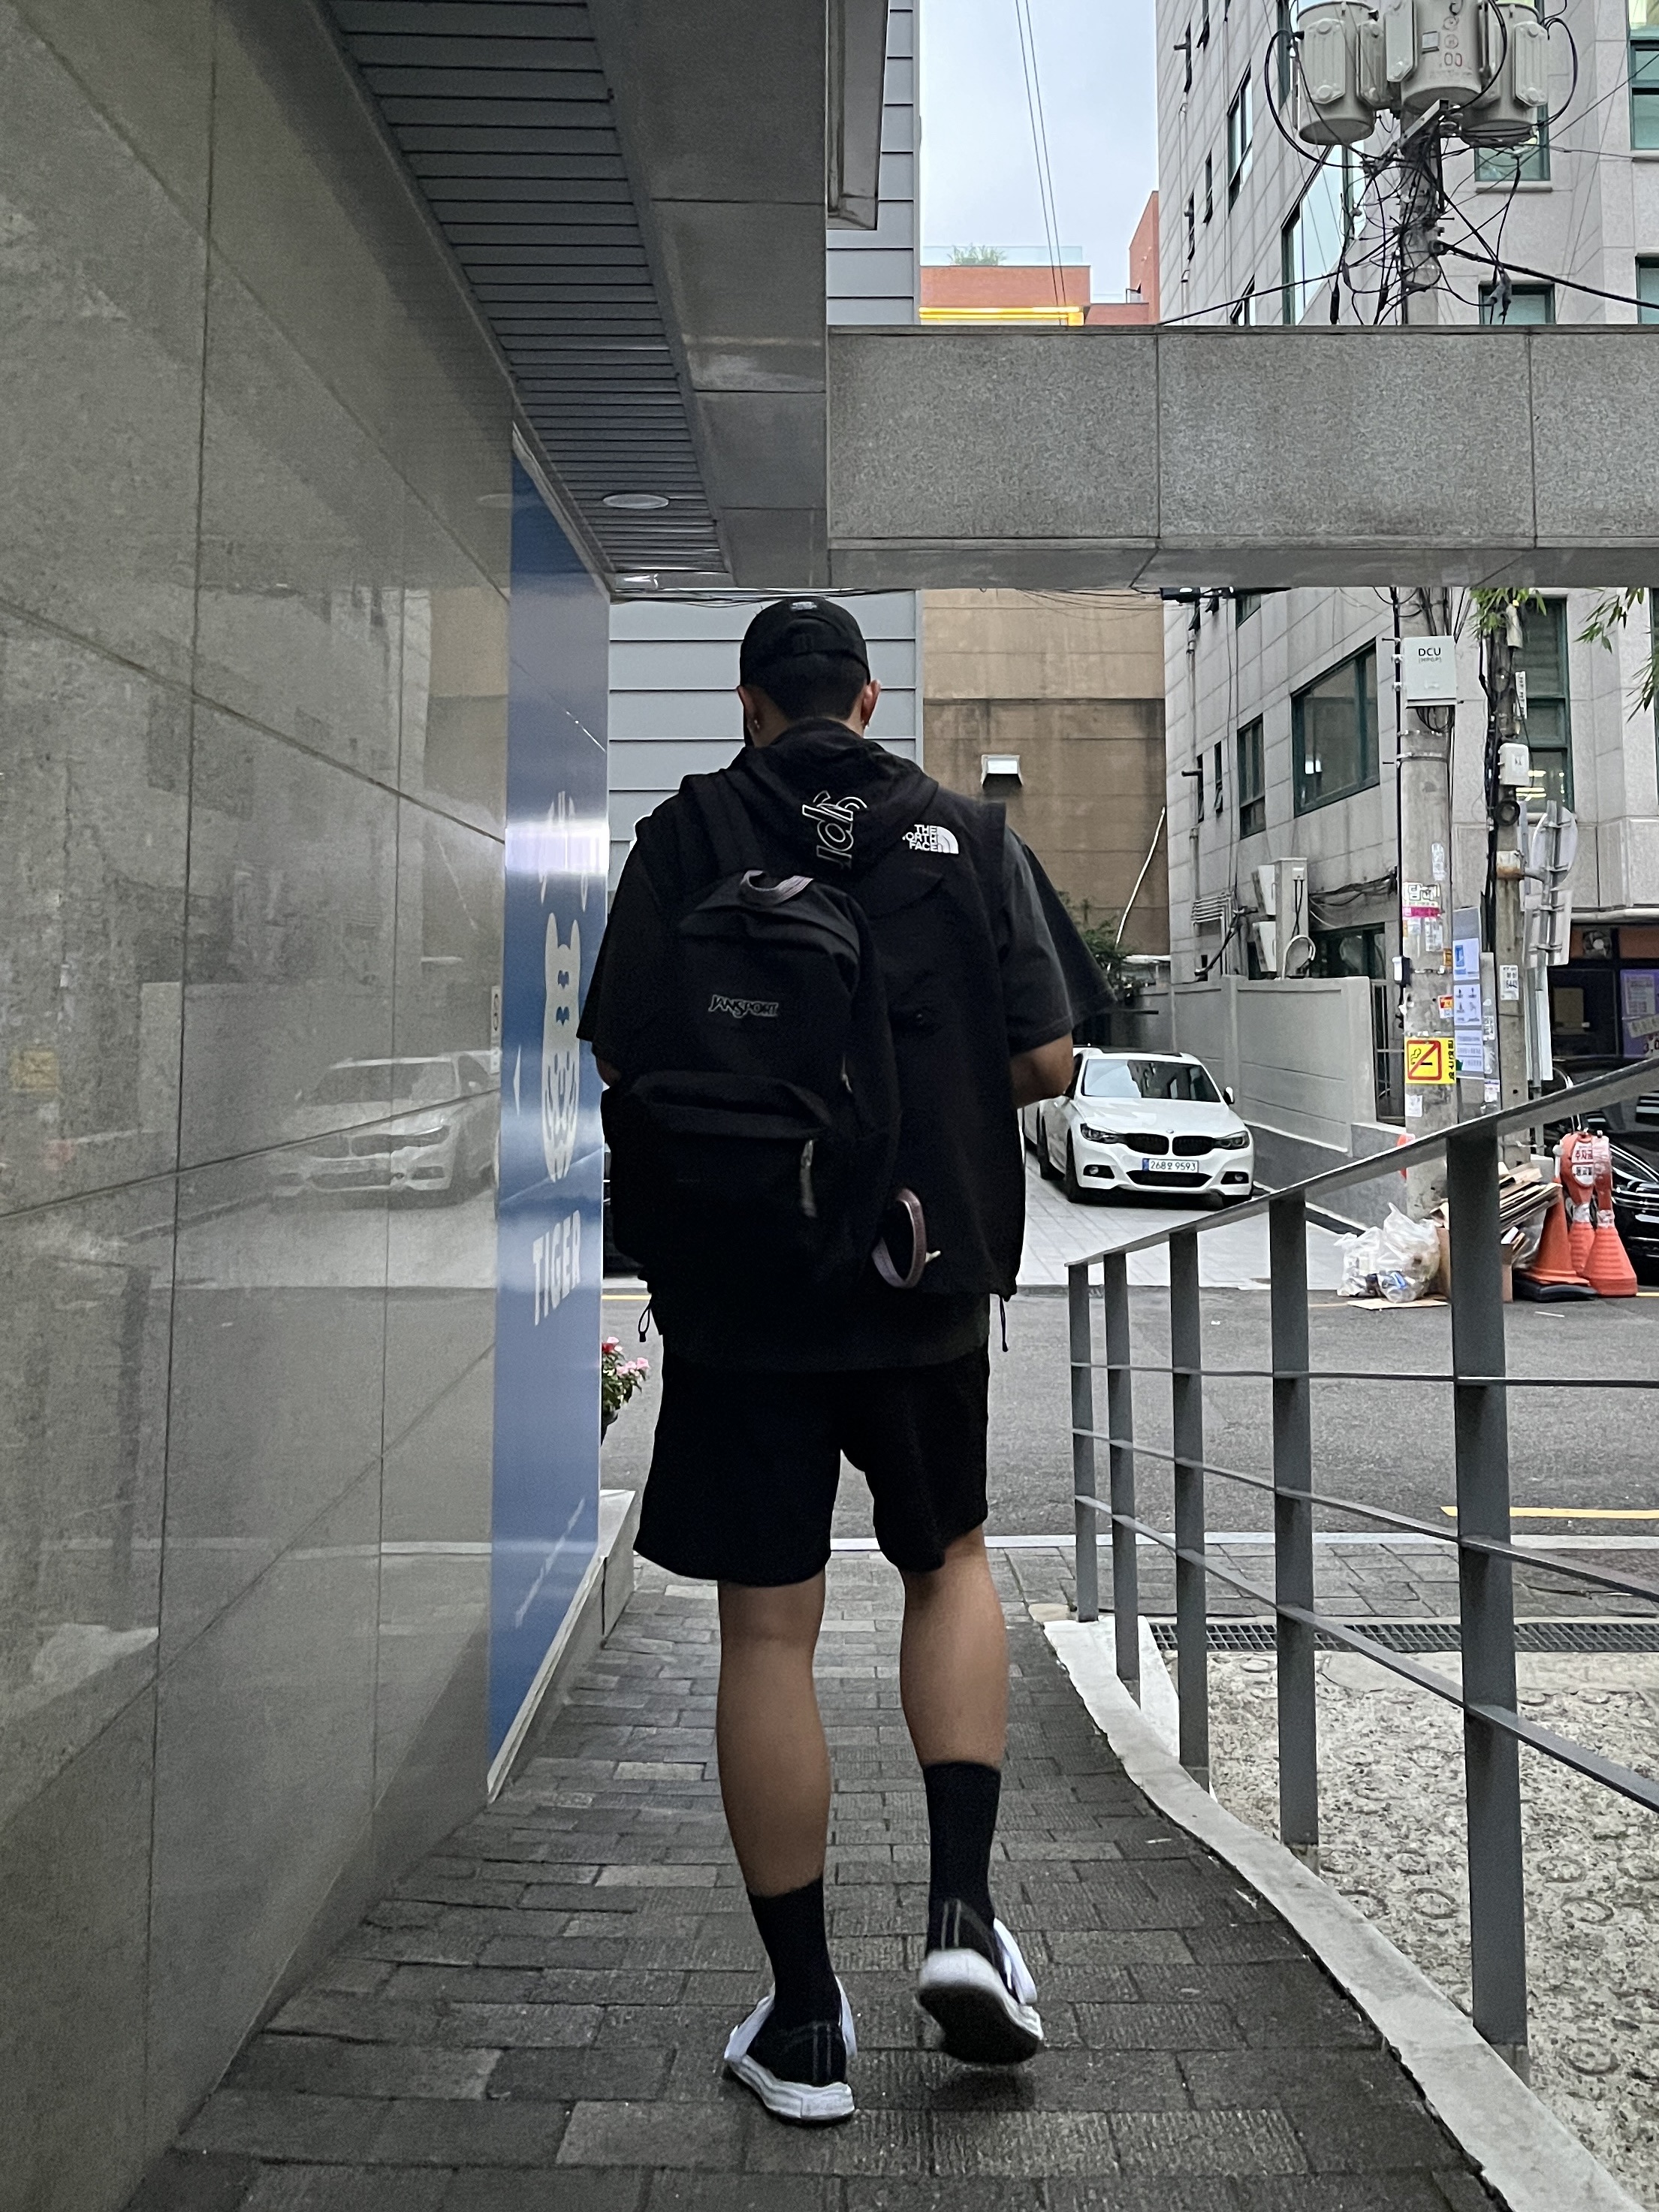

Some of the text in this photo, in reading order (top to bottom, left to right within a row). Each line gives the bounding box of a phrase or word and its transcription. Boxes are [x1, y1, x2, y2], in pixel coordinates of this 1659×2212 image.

[1418, 647, 1441, 656] DCU
[914, 824, 937, 834] THE
[909, 840, 938, 852] FACE
[1575, 1149, 1594, 1160] 주차금
[1175, 1161, 1196, 1171] 9593
[532, 1209, 581, 1326] TIGER
